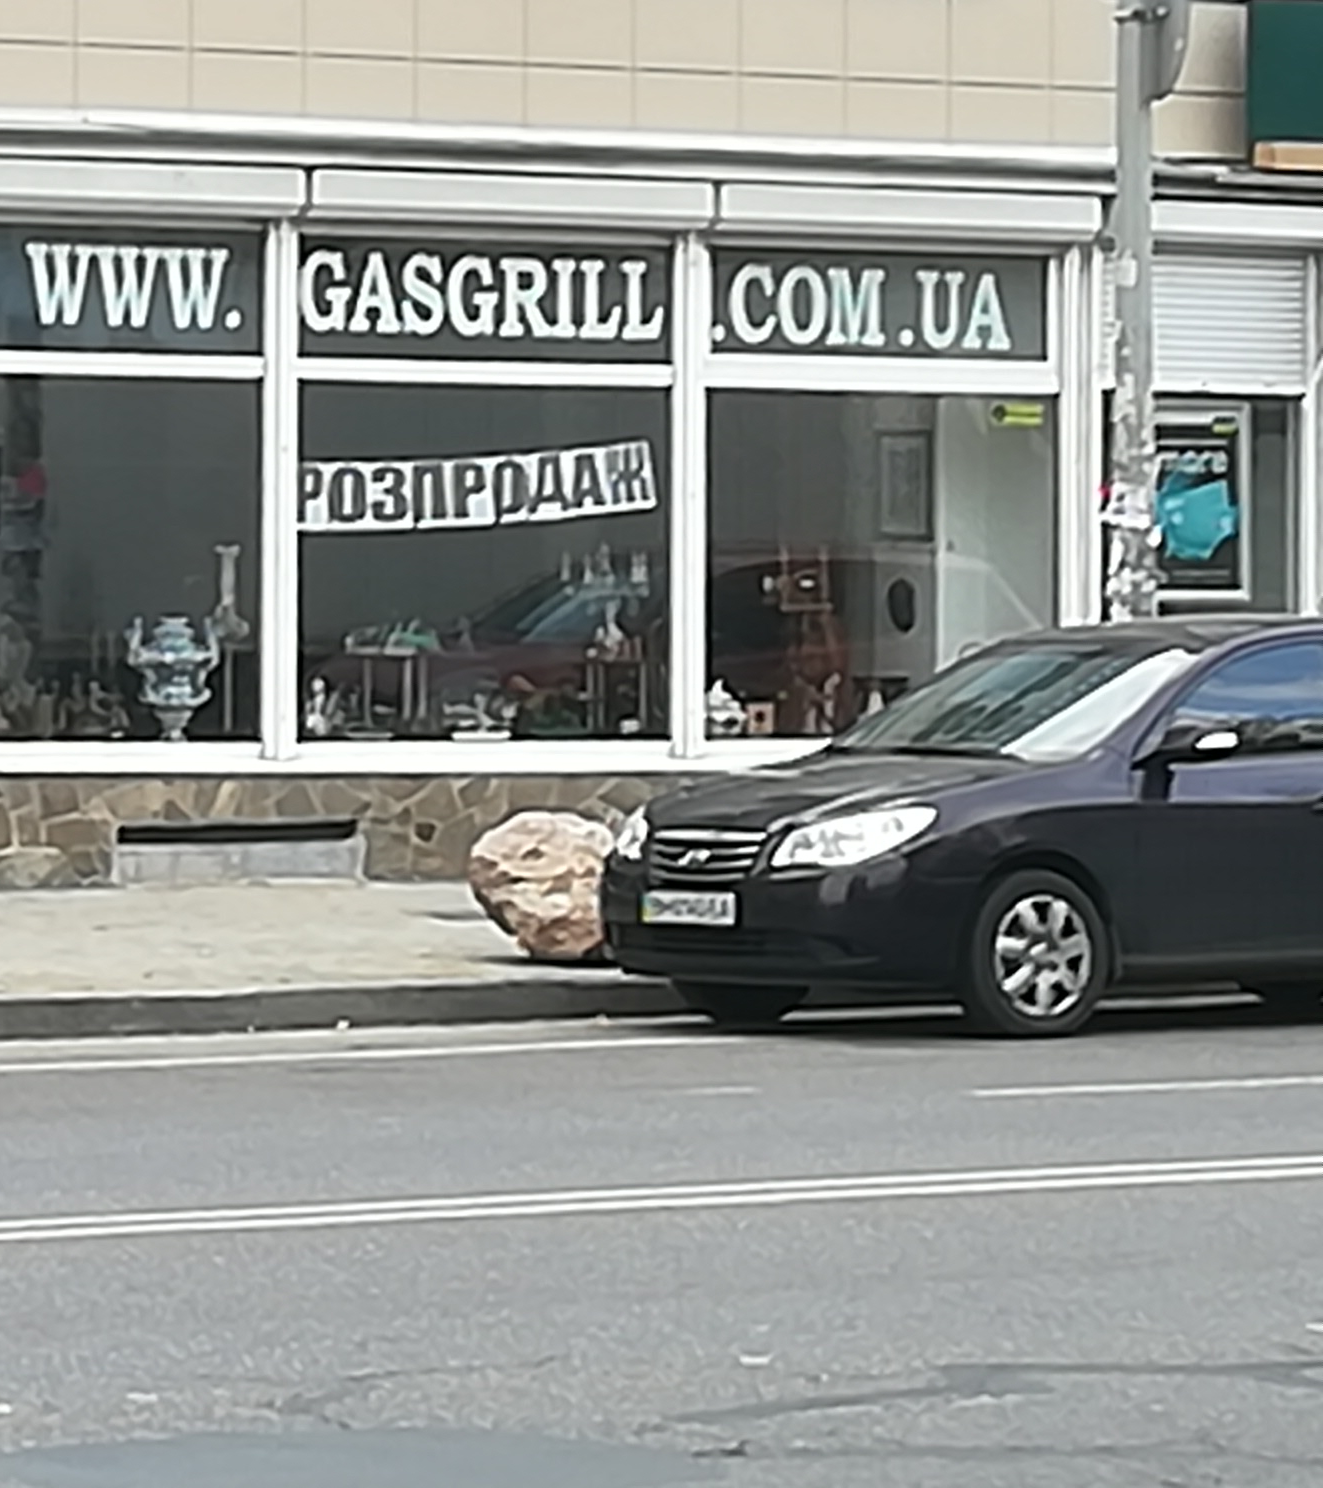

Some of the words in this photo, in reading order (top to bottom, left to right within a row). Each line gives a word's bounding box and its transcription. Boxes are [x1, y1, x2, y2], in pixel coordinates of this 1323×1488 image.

[25, 242, 243, 330] WWW.
[299, 249, 665, 341] GASGRILL
[299, 444, 652, 523] РОЗПРОДАЖ
